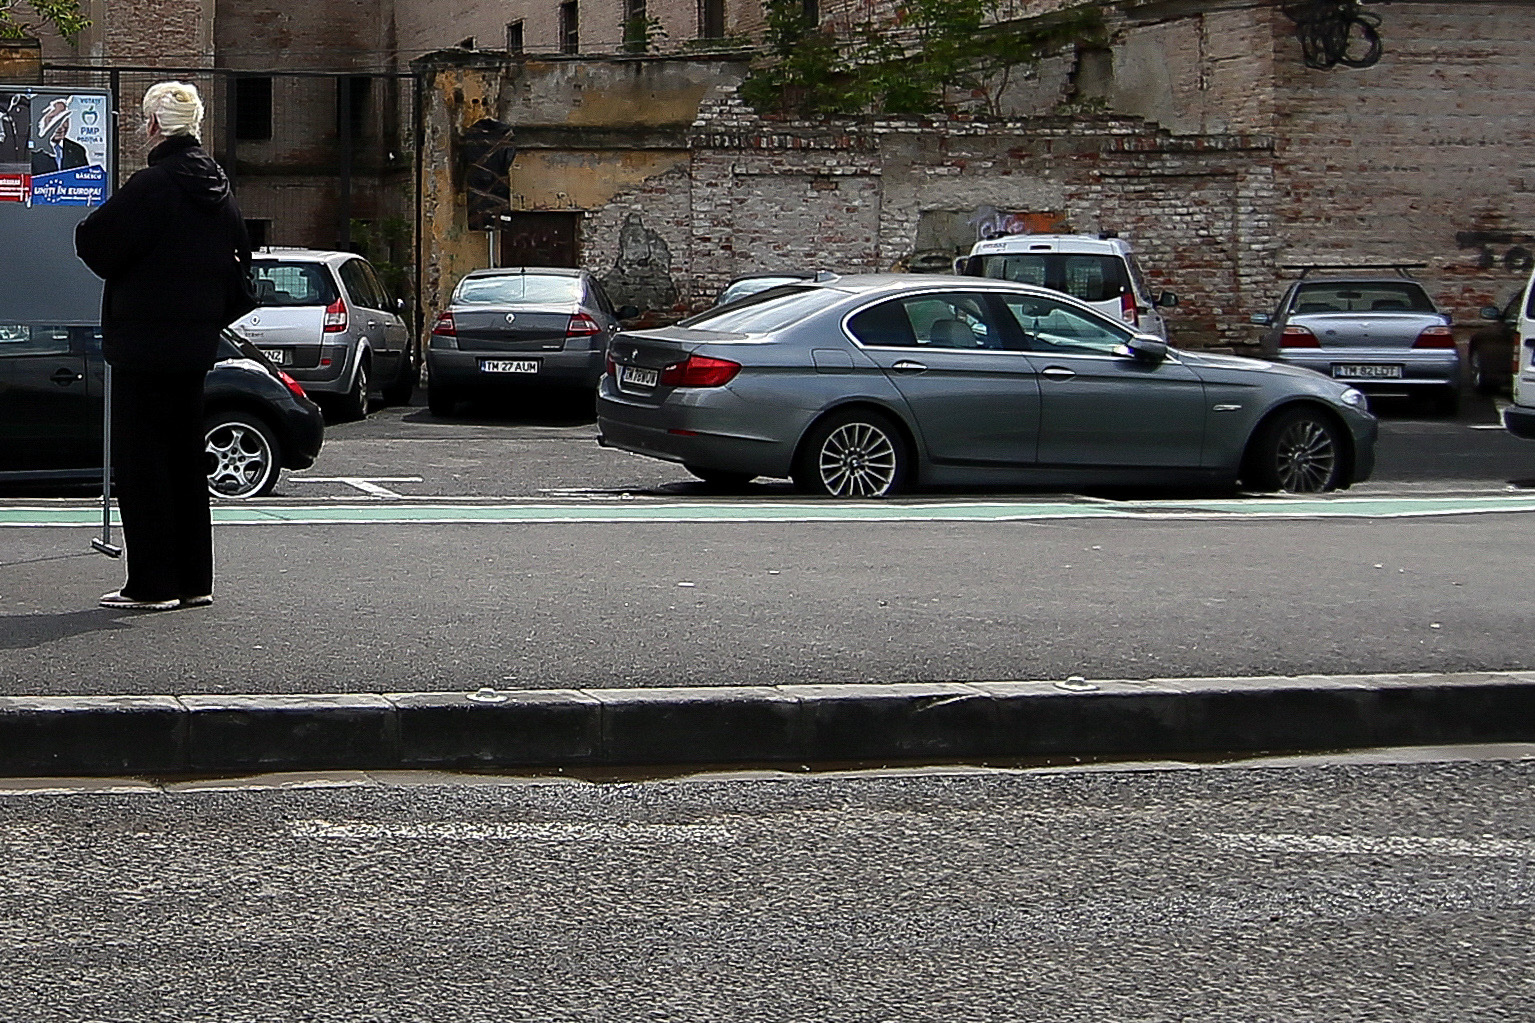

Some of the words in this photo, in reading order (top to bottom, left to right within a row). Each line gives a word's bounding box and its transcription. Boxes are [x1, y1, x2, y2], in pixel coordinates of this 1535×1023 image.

[487, 362, 498, 371] TM
[502, 362, 513, 371] 27
[515, 362, 536, 372] AUM
